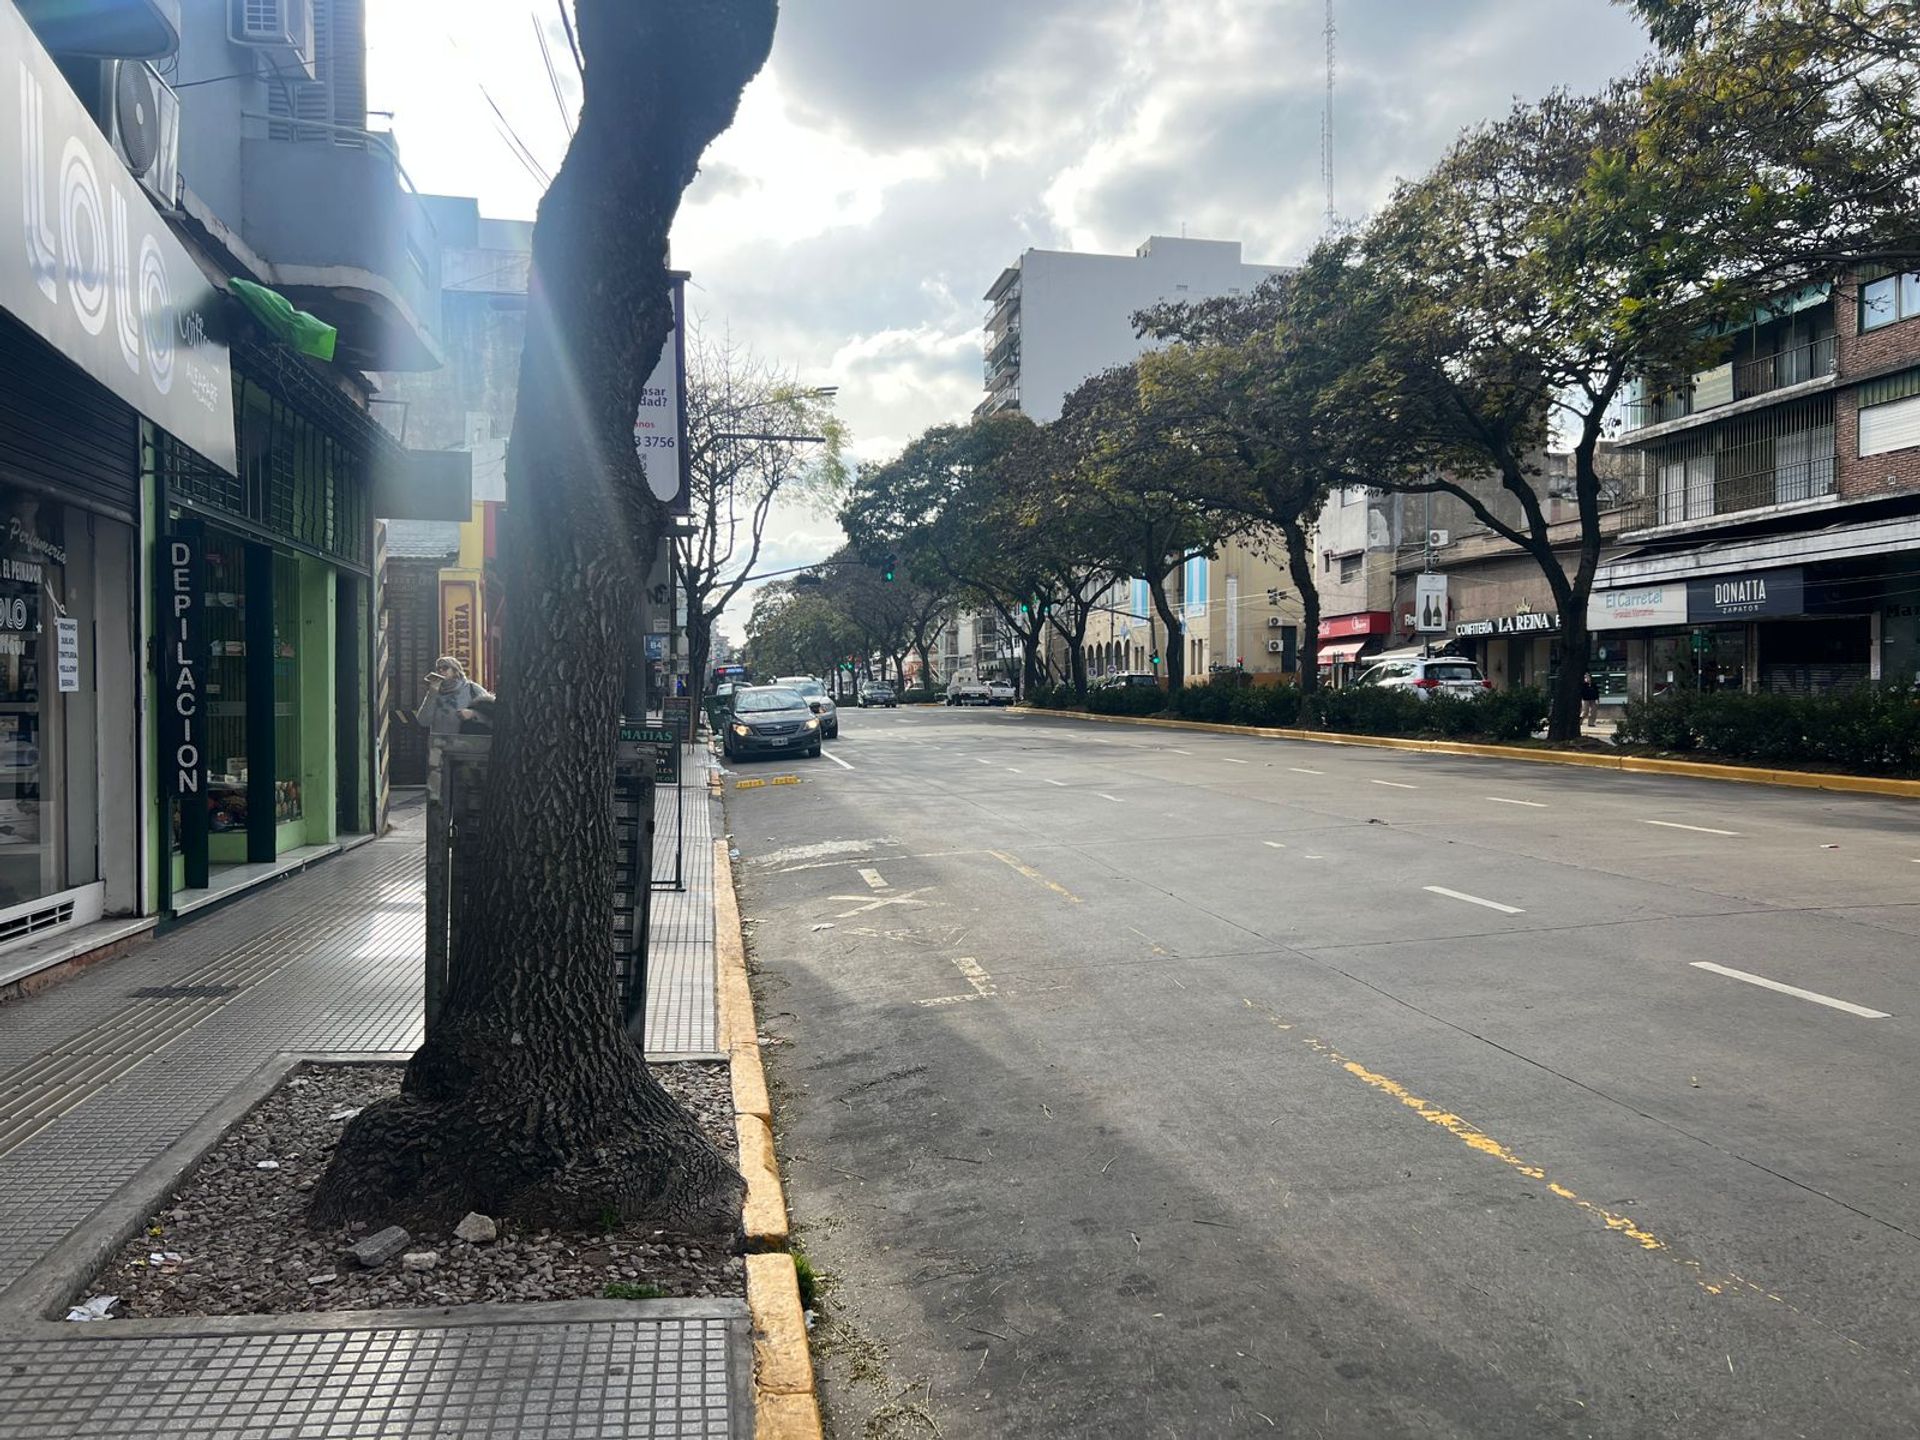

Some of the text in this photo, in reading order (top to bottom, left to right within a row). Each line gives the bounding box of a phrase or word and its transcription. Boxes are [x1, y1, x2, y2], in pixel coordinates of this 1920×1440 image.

[19, 59, 175, 395] LOLO
[640, 396, 667, 407] dad?
[644, 436, 675, 448] 3756
[1606, 588, 1663, 608] El Carretel
[1715, 579, 1766, 604] DONATTA
[1722, 605, 1759, 614] ZAPATOS
[1498, 616, 1514, 632] LA
[1516, 612, 1550, 631] REINA
[171, 542, 198, 793] DEPILACION
[621, 730, 673, 741] MATIAS
